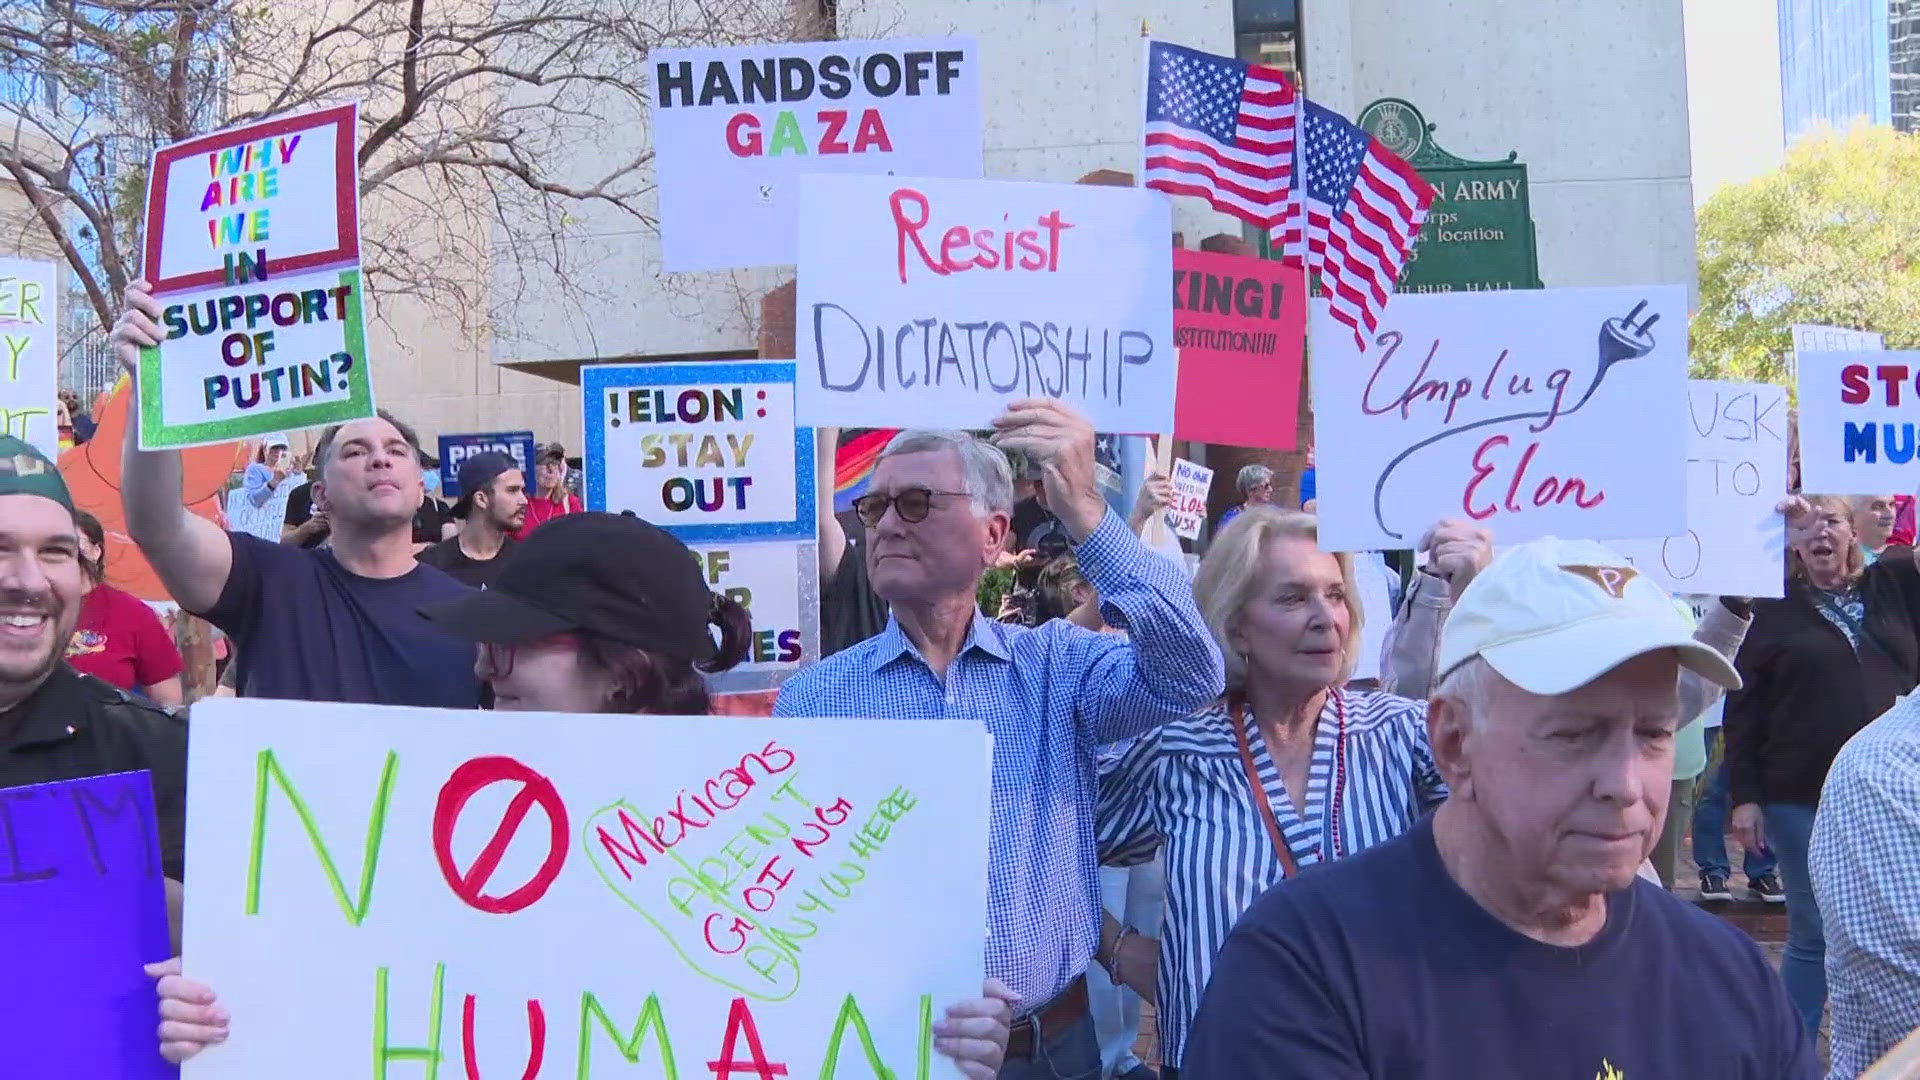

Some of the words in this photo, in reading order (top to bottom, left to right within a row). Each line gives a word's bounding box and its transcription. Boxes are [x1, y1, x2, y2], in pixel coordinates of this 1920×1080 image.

[657, 55, 851, 107] HANDS
[863, 51, 964, 97] OFF
[726, 108, 894, 157] GAZA
[209, 135, 301, 178] WHY
[200, 167, 278, 212] ARE
[1454, 179, 1521, 201] ARMY
[208, 209, 270, 249] WE
[889, 188, 1076, 284] Resist
[1438, 228, 1504, 243] location
[223, 248, 268, 286] IN
[162, 284, 351, 340] SUPPORT
[1173, 270, 1284, 320] KING!
[221, 330, 275, 368] OF
[203, 351, 353, 411] PUTIN?
[1361, 331, 1571, 433] Unplug
[1840, 364, 1920, 407] ST
[641, 432, 754, 468] STAY
[1843, 421, 1920, 465] MU
[662, 476, 752, 512] OUT
[1463, 435, 1605, 520] Elon
[744, 629, 801, 664] ES
[596, 741, 795, 881] Mexicans
[704, 797, 853, 955] GOING
[744, 786, 919, 984] ANYWHERE
[371, 961, 932, 1080] HUMAN
